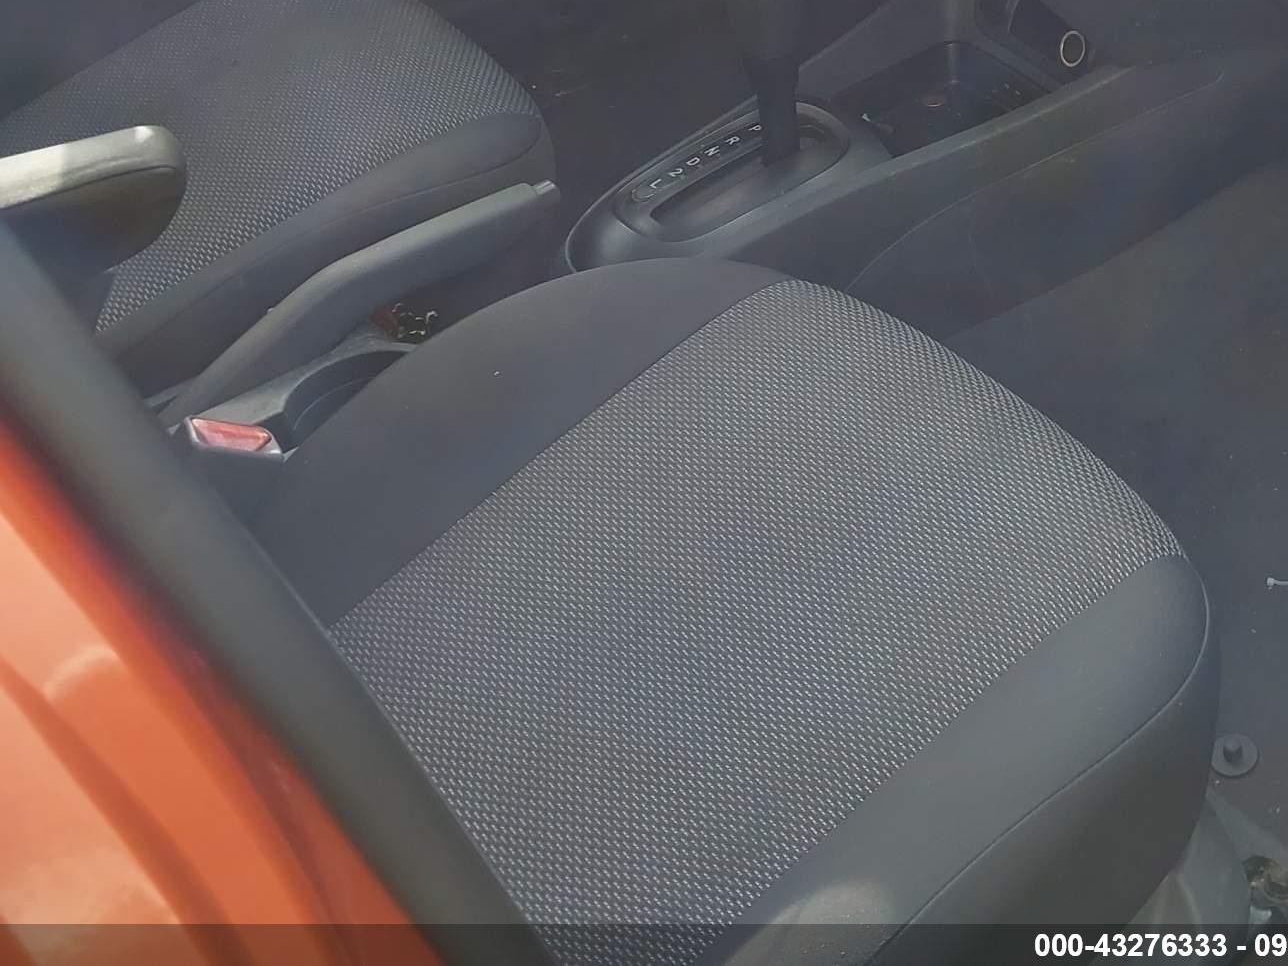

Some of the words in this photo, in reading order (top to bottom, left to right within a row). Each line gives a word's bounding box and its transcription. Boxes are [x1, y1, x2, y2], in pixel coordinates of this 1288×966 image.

[650, 178, 662, 189] L
[668, 167, 683, 178] 2
[686, 156, 701, 167] D
[704, 145, 721, 156] N
[725, 135, 741, 146] R
[748, 124, 763, 133] P
